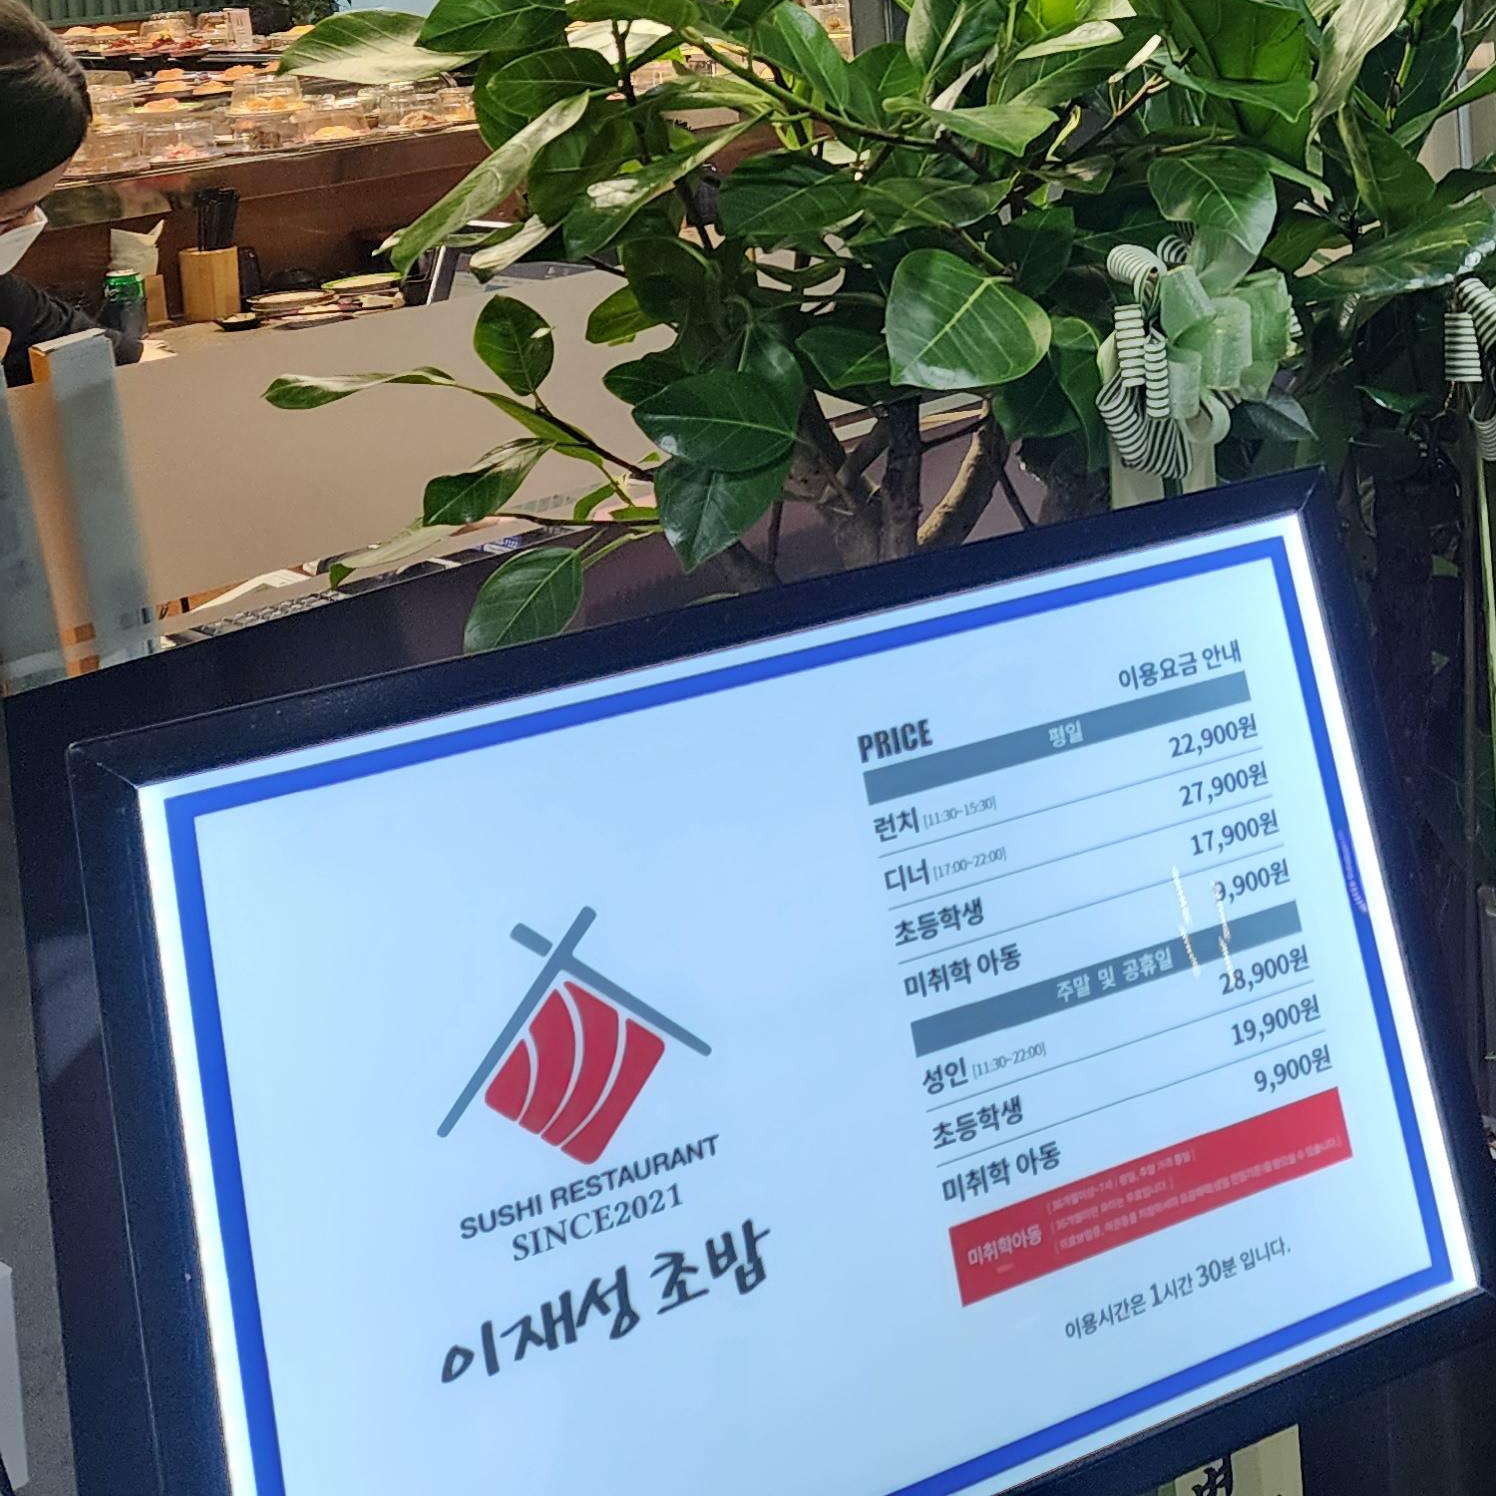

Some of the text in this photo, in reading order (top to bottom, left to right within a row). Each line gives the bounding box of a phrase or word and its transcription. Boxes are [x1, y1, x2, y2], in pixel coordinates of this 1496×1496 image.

[1118, 639, 1242, 691] 이용요금 안내
[857, 718, 933, 764] PRICE
[1048, 719, 1084, 748] 평일
[1168, 712, 1258, 759] 22,900원
[1179, 760, 1269, 808] 27,900원
[873, 806, 920, 843] 런치
[1190, 808, 1280, 857] 17,900원
[884, 858, 930, 892] 디너
[1213, 858, 1291, 904] 9,900원
[894, 896, 984, 947] 초등학생
[904, 942, 1022, 998] 미취학 아동
[1056, 947, 1173, 1003] 주말 및 공휴일
[1219, 944, 1311, 995] 28,900원
[1231, 994, 1321, 1046] 19,900원
[922, 1056, 969, 1096] 성인
[1254, 1044, 1333, 1093] 9,900원
[932, 1094, 1024, 1150] 초등학생
[460, 1134, 720, 1240] SUSHI RESTAURANT
[941, 1157, 1011, 1204] 미취학
[1015, 1140, 1062, 1177] 아동
[511, 1182, 684, 1262] SINCE2021
[1064, 1236, 1292, 1340] 이용시간은 1시간 30분 입니다.
